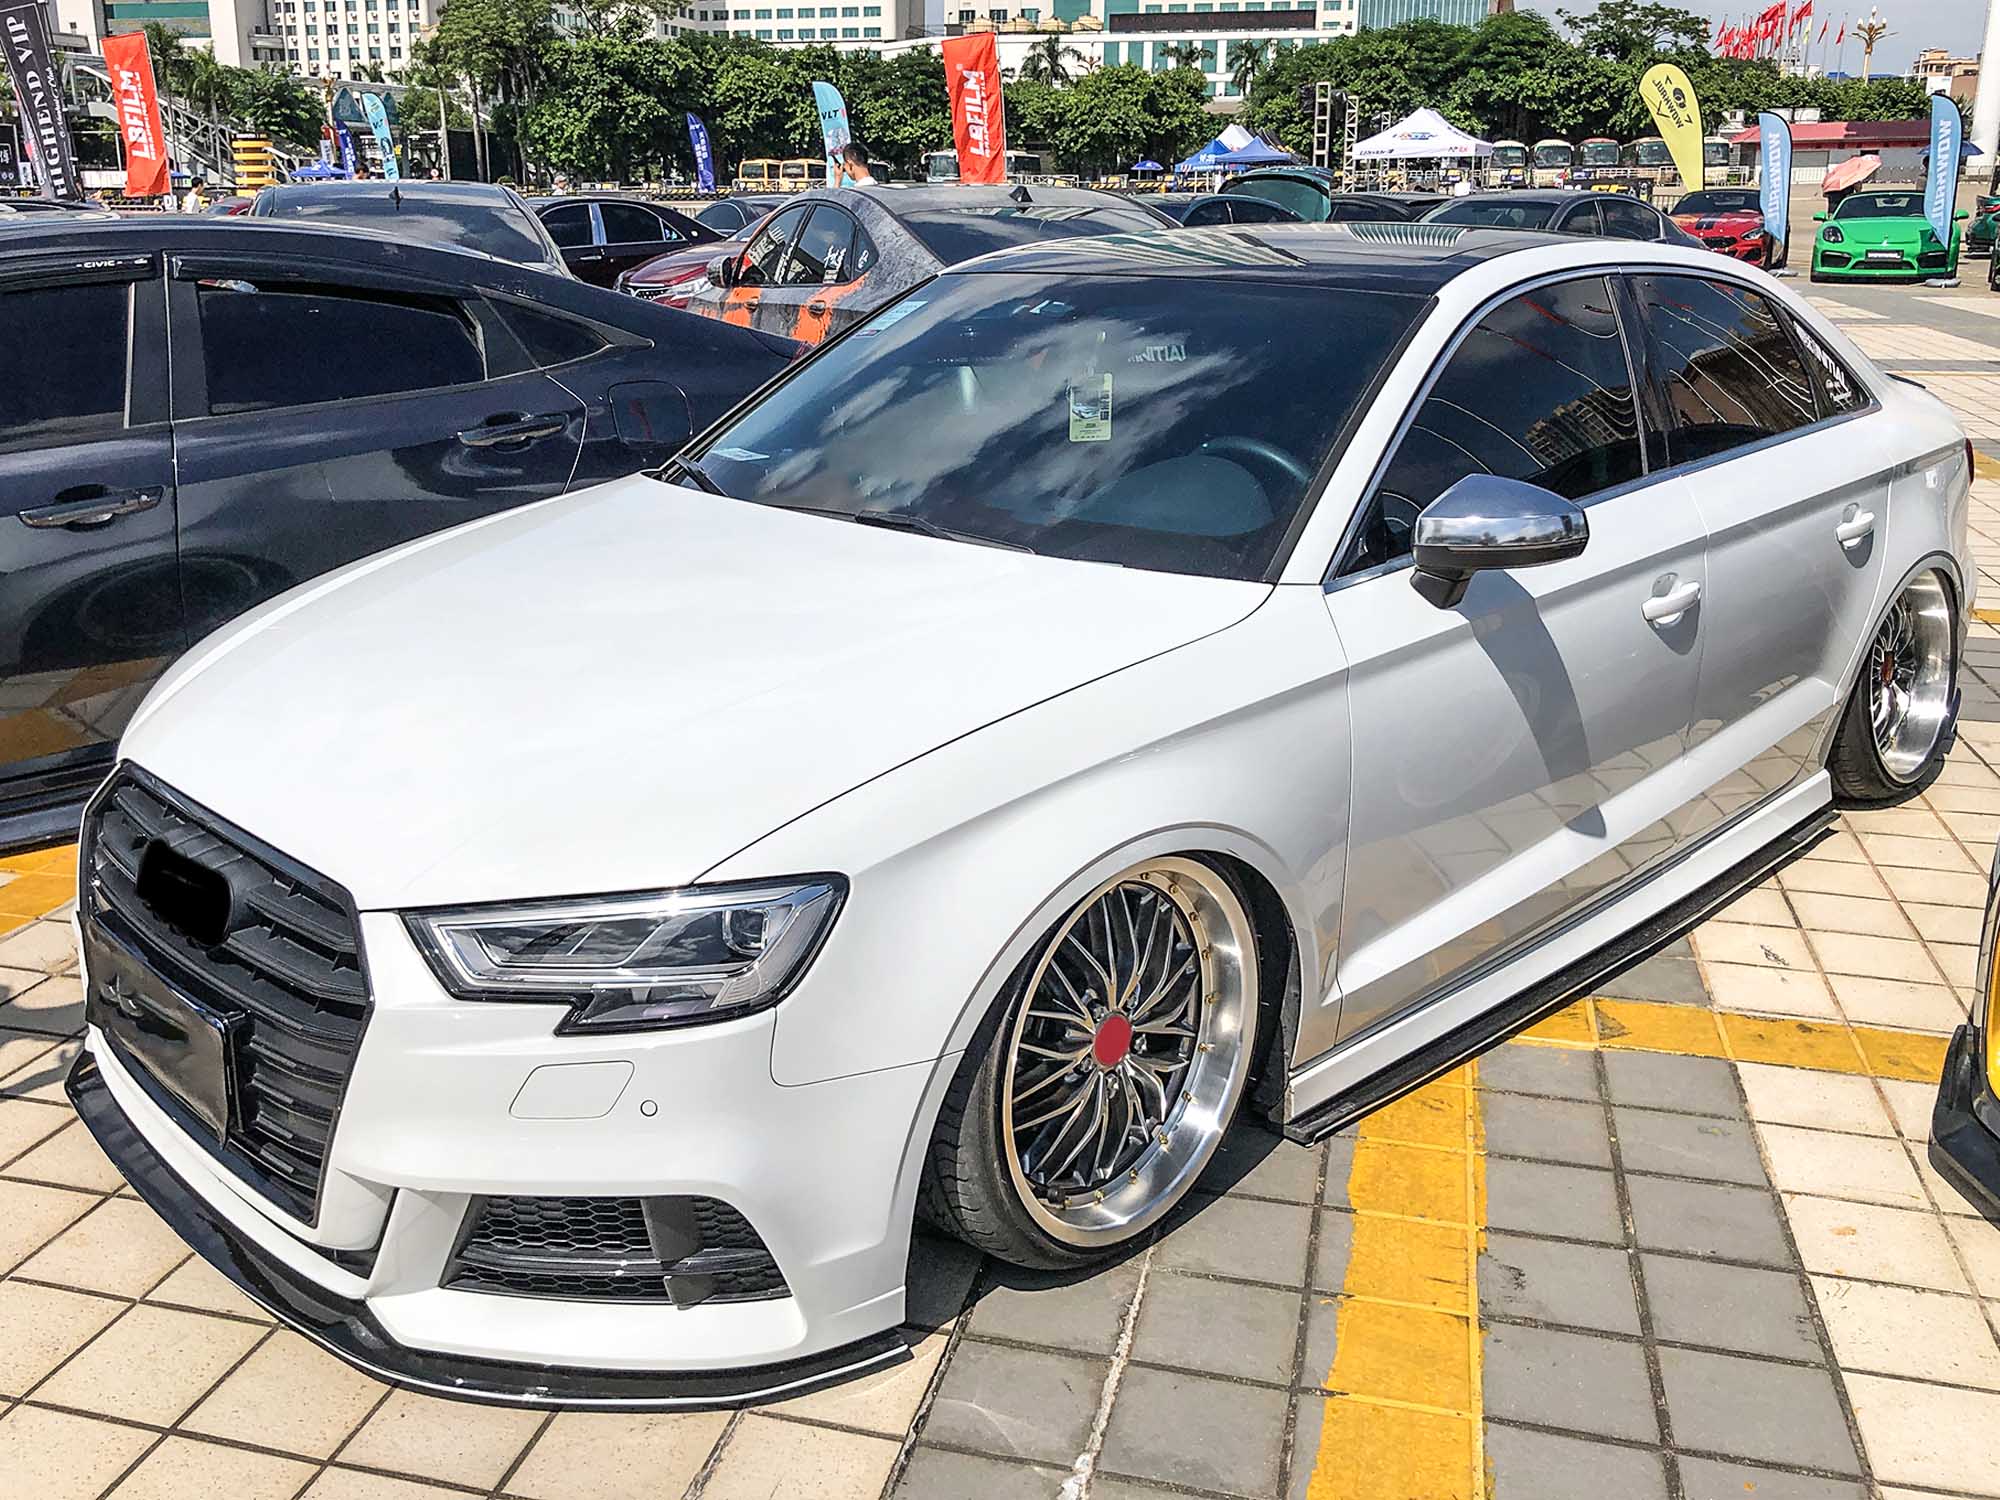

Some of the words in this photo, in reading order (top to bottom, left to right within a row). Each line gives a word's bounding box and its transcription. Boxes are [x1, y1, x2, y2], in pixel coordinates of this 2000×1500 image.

[6, 16, 33, 64] VIP
[119, 69, 151, 160] LBFILM
[821, 109, 839, 120] VLT
[962, 69, 985, 157] LBFILM
[83, 260, 116, 269] CIVIC
